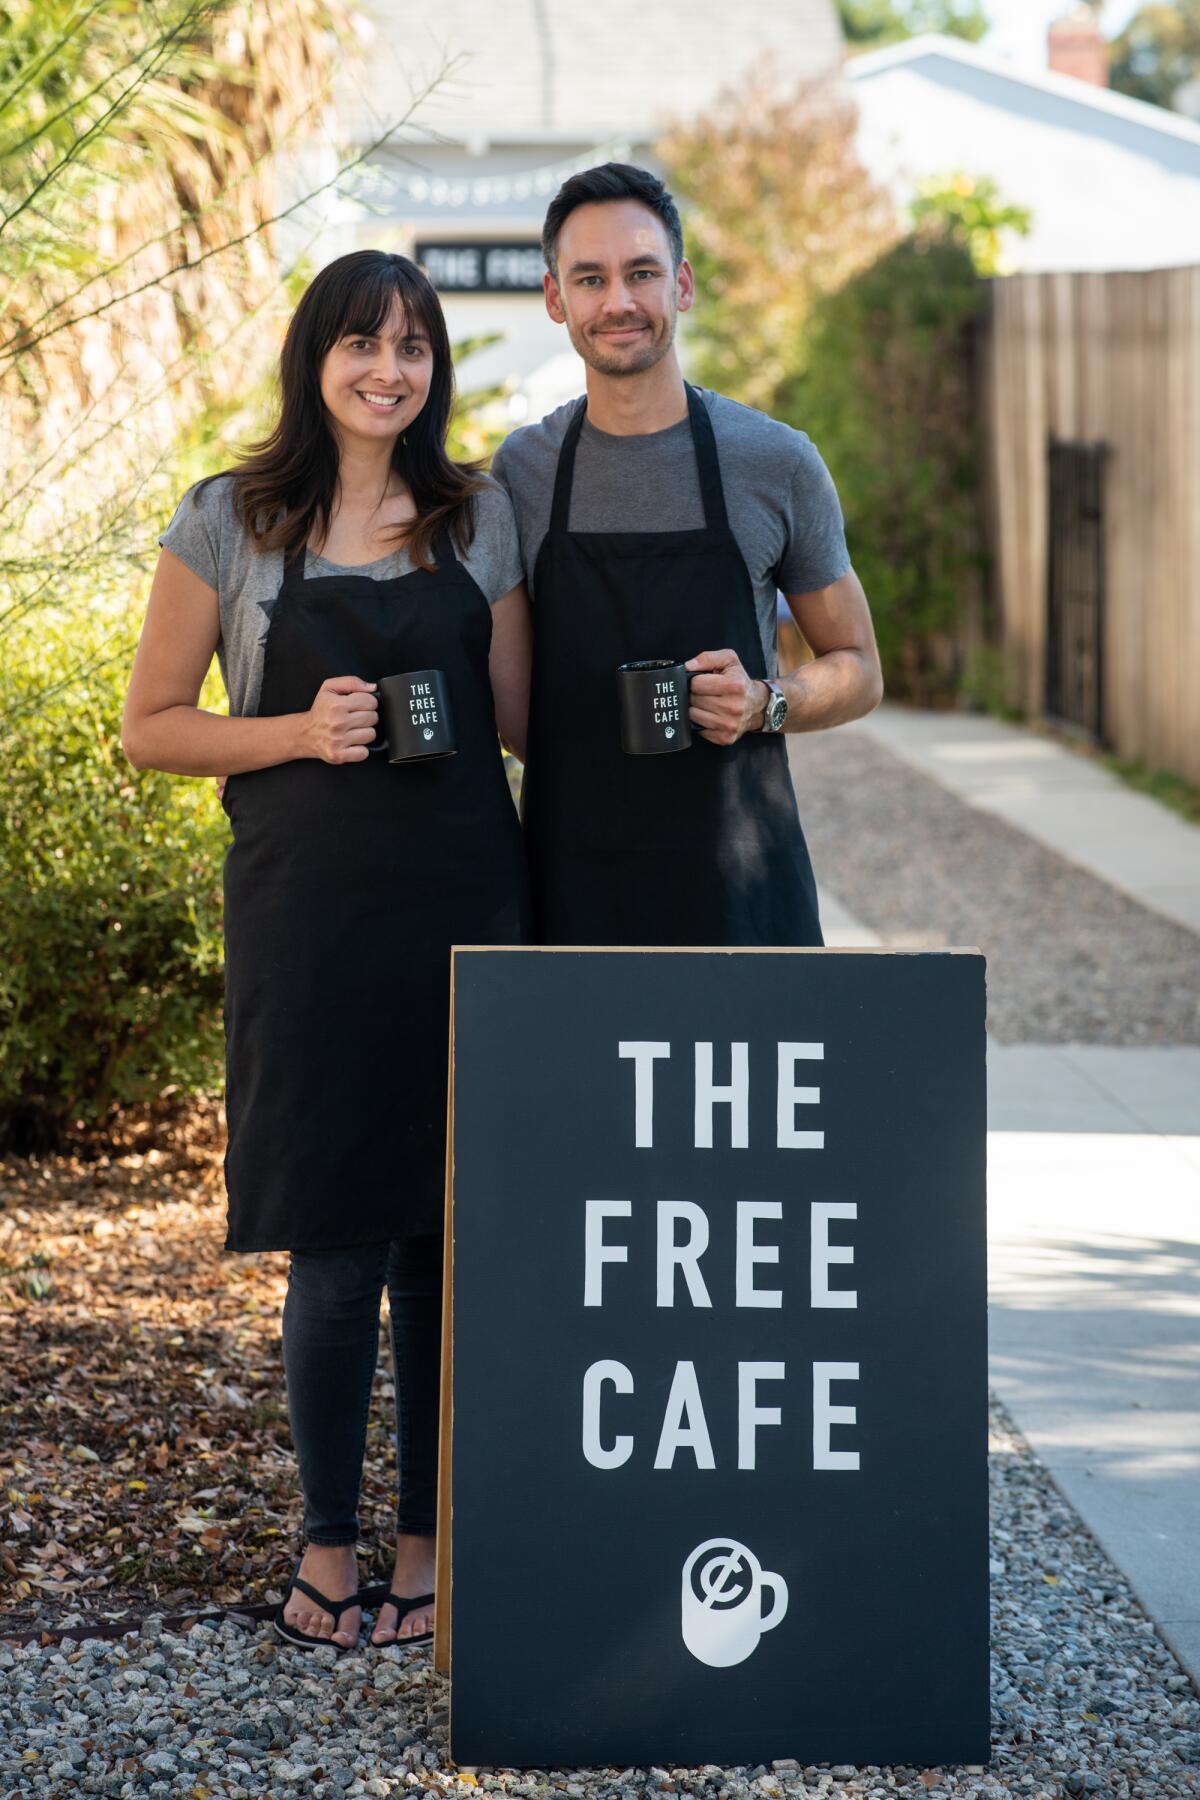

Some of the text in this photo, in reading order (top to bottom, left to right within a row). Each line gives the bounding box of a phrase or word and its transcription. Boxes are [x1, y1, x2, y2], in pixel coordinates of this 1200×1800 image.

[423, 248, 479, 287] THE
[410, 683, 431, 696] THE
[655, 681, 675, 694] THE
[409, 697, 436, 711] FREE
[653, 695, 679, 709] FREE
[411, 711, 438, 726] CAFE
[654, 709, 680, 724] CAFE
[618, 1041, 825, 1149] THE
[583, 1199, 859, 1309] FREE
[582, 1359, 861, 1471] CAFE
